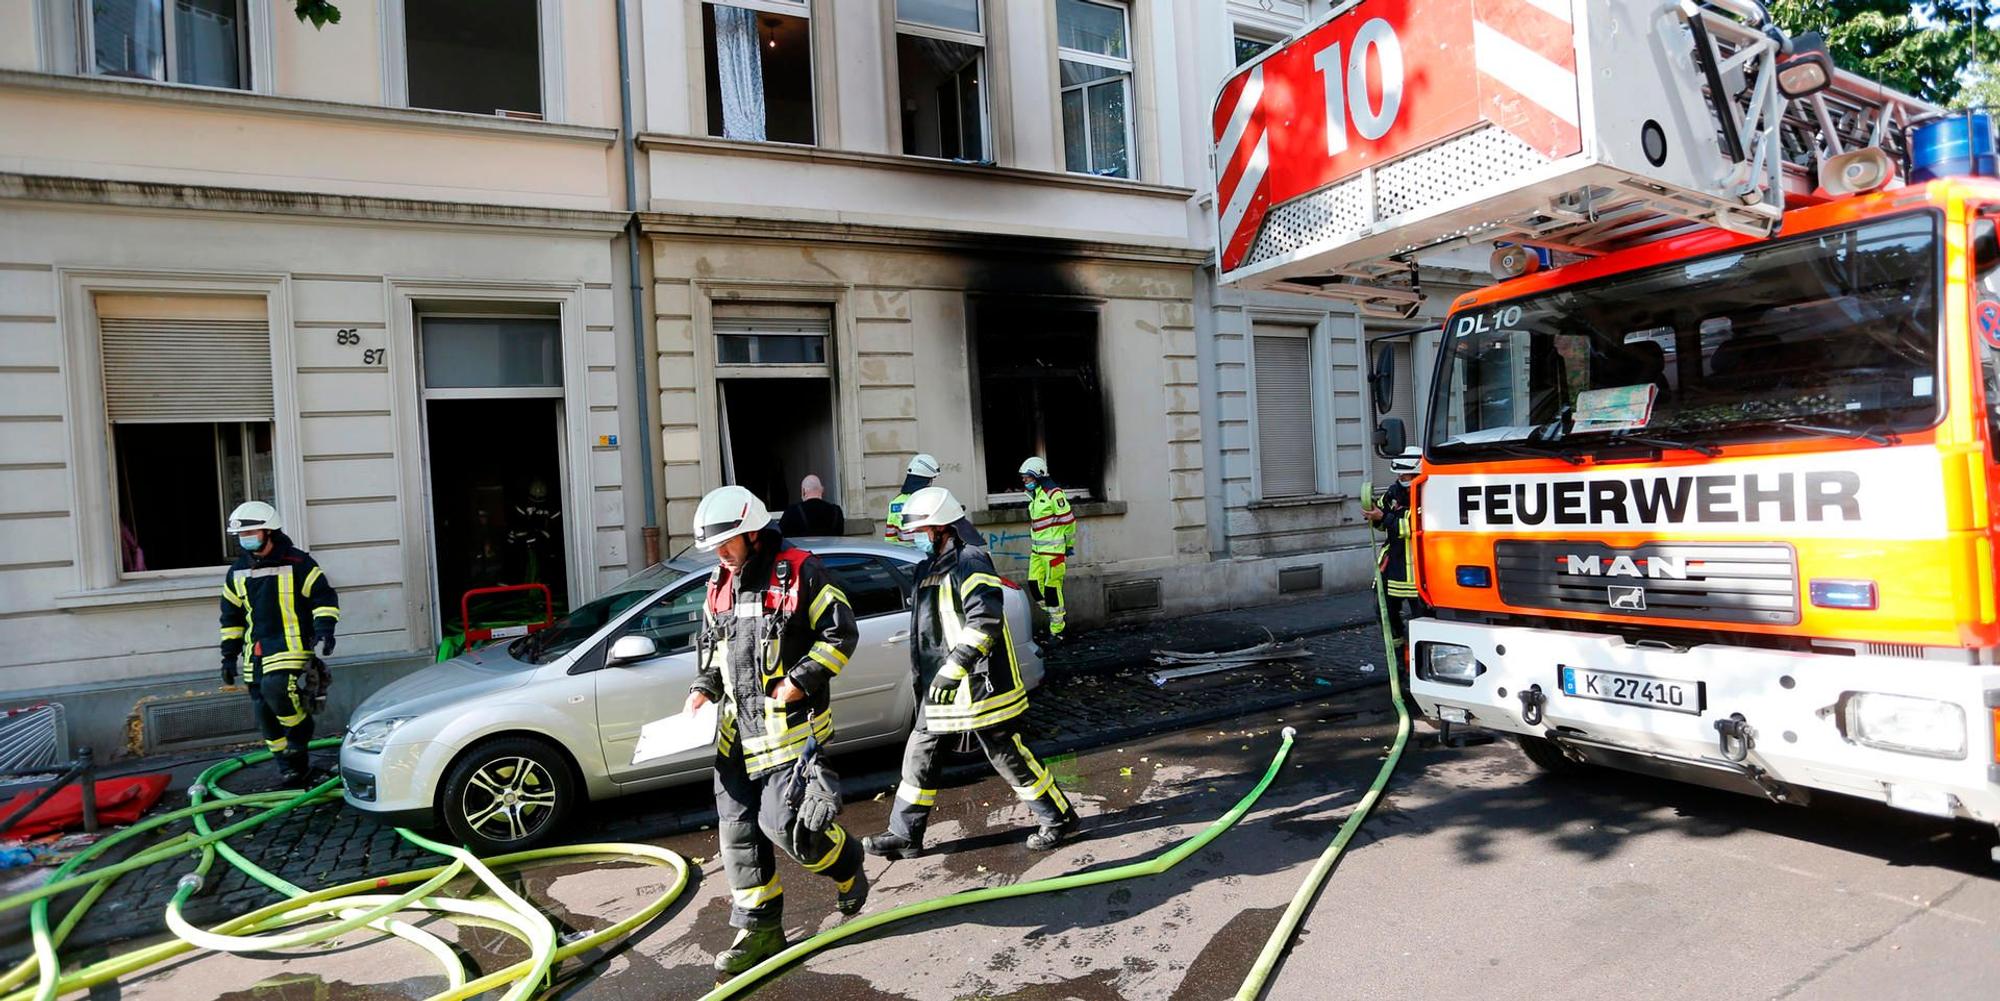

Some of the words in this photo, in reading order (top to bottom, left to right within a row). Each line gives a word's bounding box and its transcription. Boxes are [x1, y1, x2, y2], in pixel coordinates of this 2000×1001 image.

[1313, 17, 1404, 157] 10
[337, 328, 360, 345] 85
[363, 348, 385, 365] 87
[1457, 471, 1862, 525] FEUERWEHR
[1567, 554, 1688, 580] MAN
[1586, 674, 1599, 694] K
[1613, 677, 1683, 706] 27410
